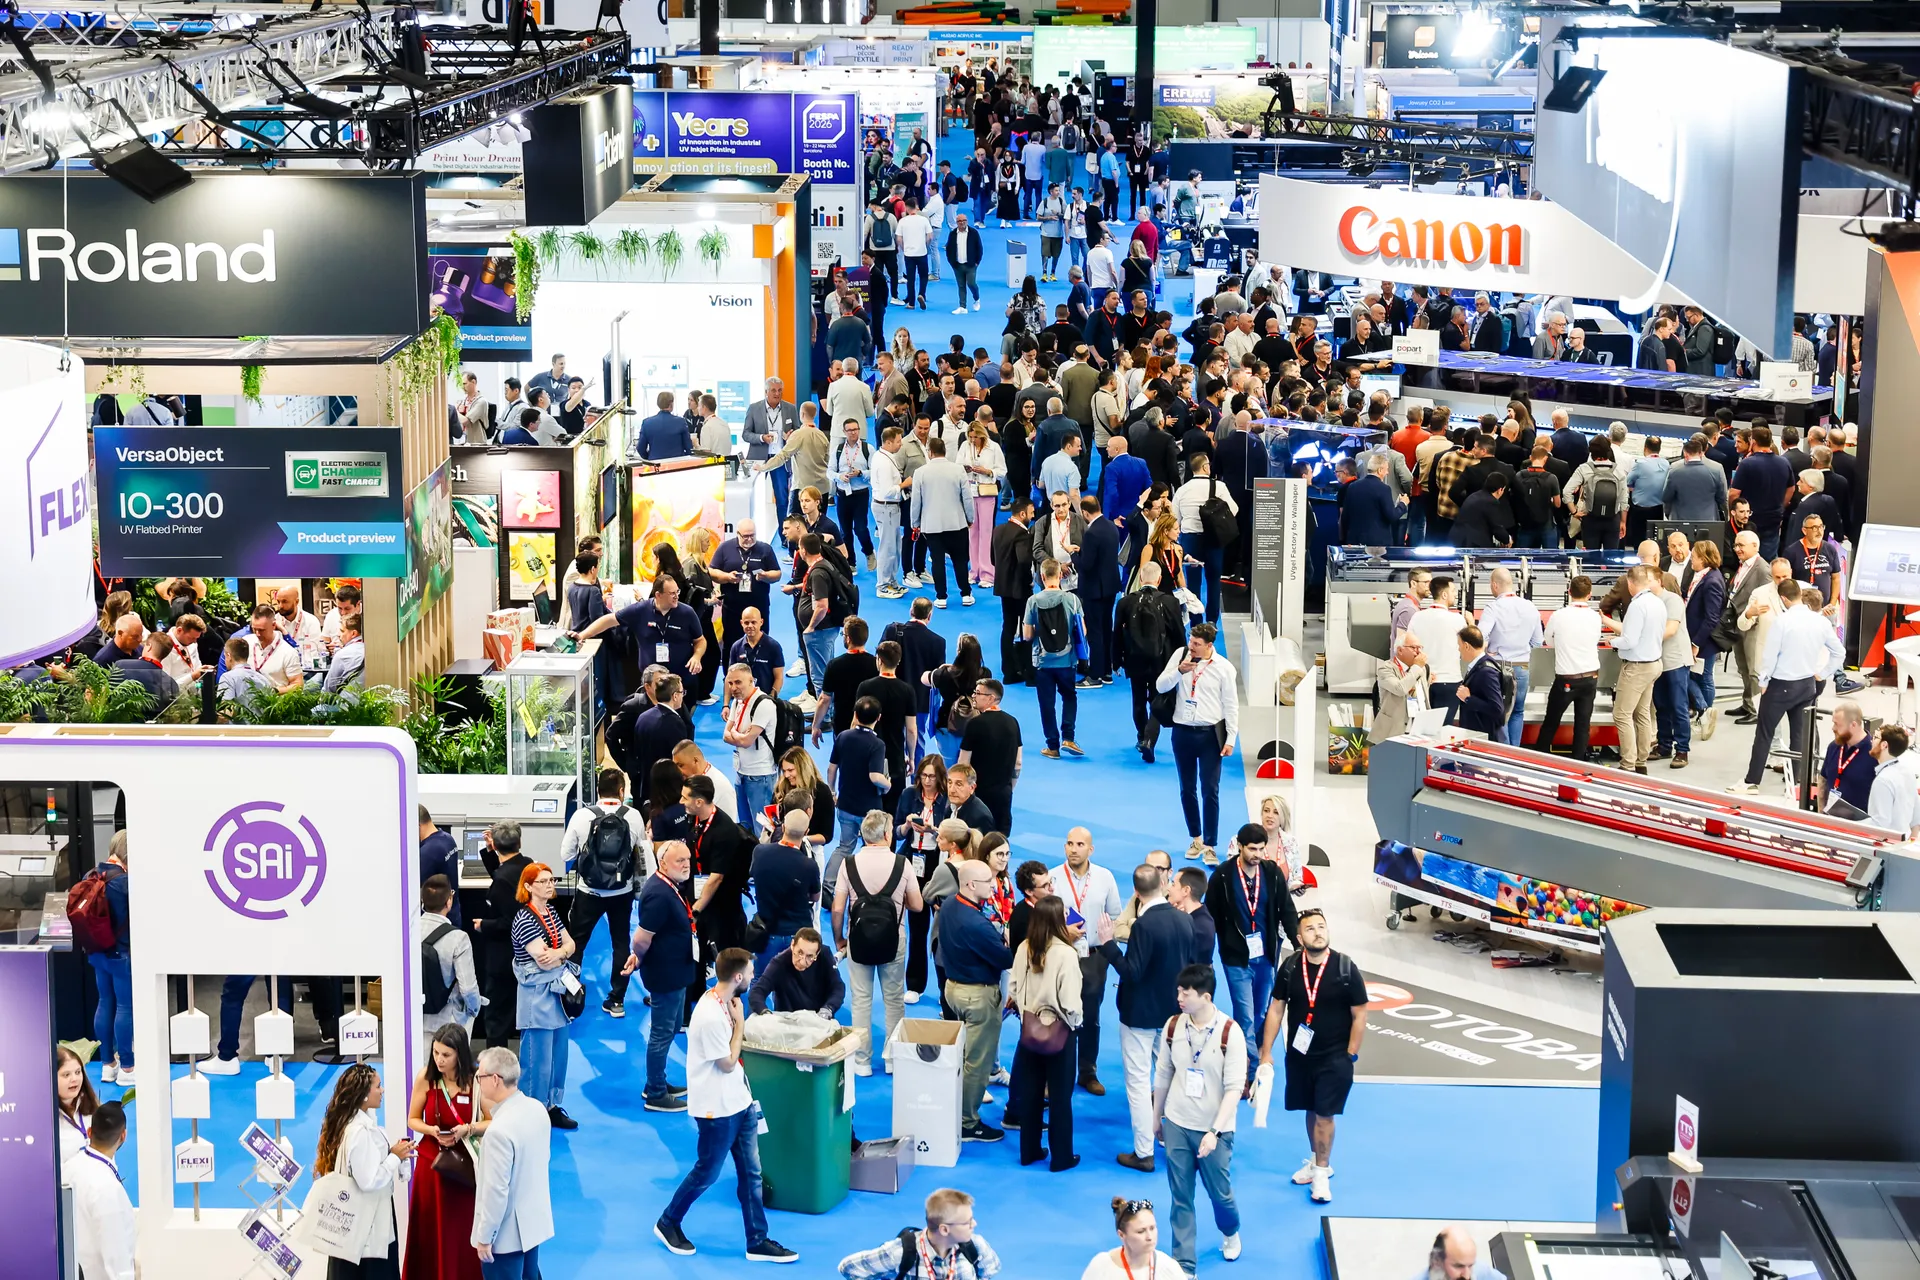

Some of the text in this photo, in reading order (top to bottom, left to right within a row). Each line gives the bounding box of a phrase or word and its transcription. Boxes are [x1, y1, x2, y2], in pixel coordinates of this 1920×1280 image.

[671, 112, 749, 137] Years
[809, 120, 833, 128] 2026
[603, 127, 625, 170] Roland
[690, 146, 709, 154] Inkjet
[710, 146, 736, 154] Printing
[433, 153, 521, 163] Print Your Dream
[803, 158, 850, 169] Booth No.
[702, 159, 716, 173] at
[717, 159, 732, 173] its
[734, 158, 771, 173] finest!
[1339, 206, 1523, 267] Canon
[26, 228, 277, 283] Roland
[709, 295, 753, 307] Vision
[463, 333, 527, 343] Product preview
[1396, 345, 1422, 354] popart
[115, 446, 224, 465] VersaObject
[322, 478, 380, 486] FAST CHARGE
[119, 492, 224, 519] IO-300
[1291, 483, 1300, 518] Wallpaper
[119, 524, 203, 535] UV Flatbed Printer
[297, 532, 396, 545] Product preview
[1290, 532, 1298, 558] Factory
[1290, 559, 1298, 580] UVgel
[1434, 830, 1463, 846] FOTOBA
[234, 842, 293, 880] SAi
[1376, 877, 1398, 891] Canon
[1440, 900, 1452, 909] TTS
[345, 1031, 374, 1039] FLEXI
[1378, 1025, 1425, 1045] print
[0, 1102, 17, 1113] NT
[1679, 1118, 1694, 1137] TTS
[180, 1157, 209, 1165] FLEXI
[329, 1203, 342, 1213] Turn
